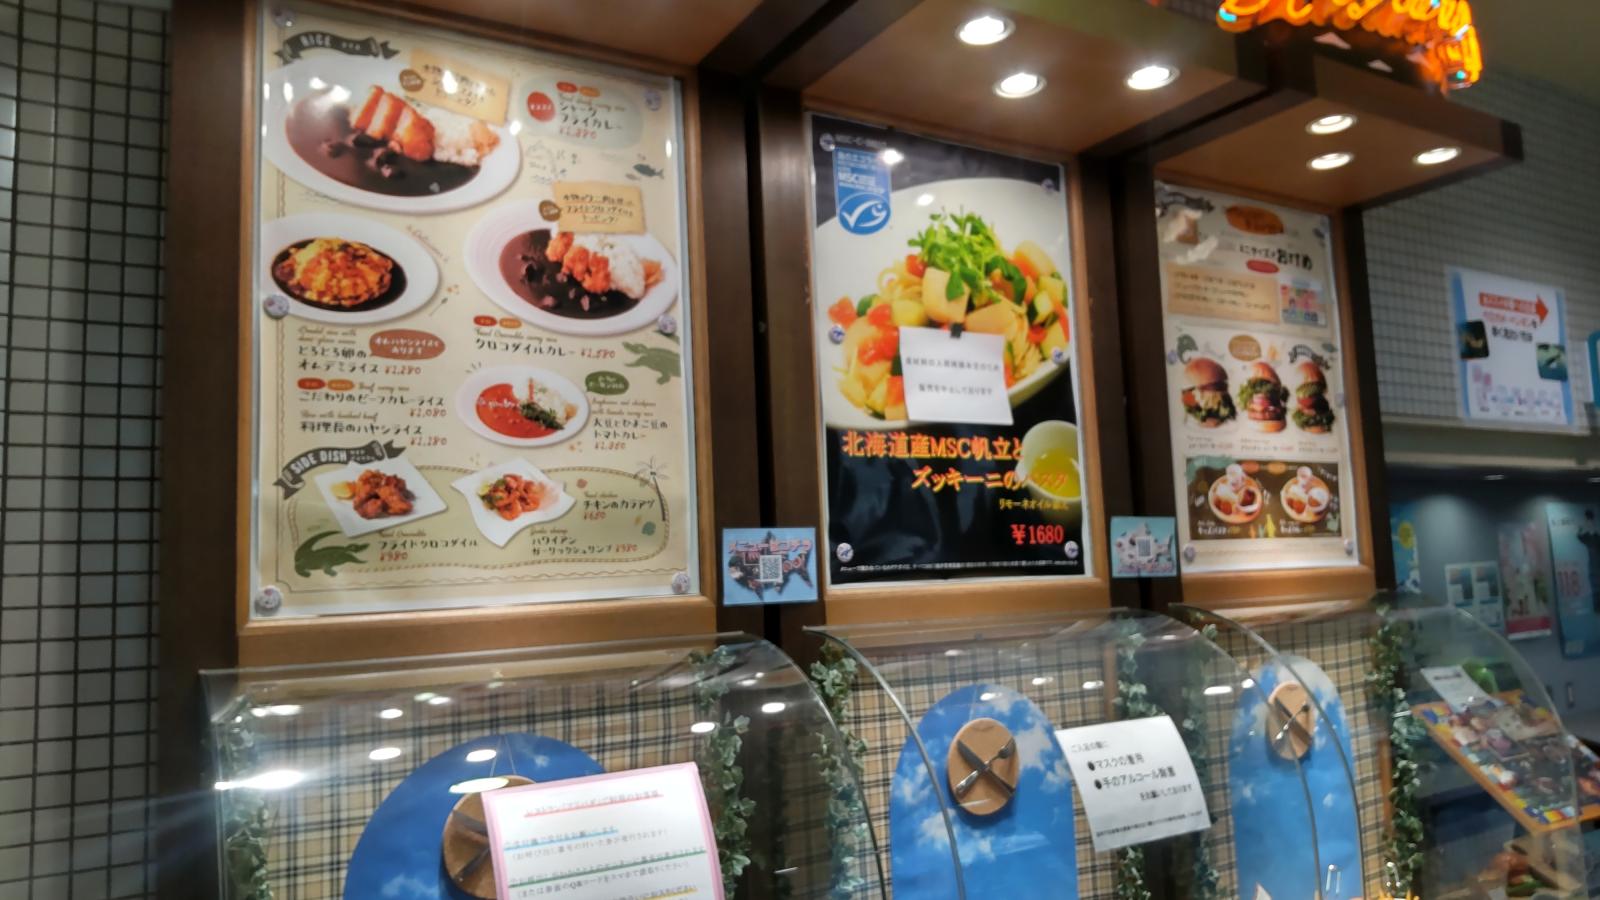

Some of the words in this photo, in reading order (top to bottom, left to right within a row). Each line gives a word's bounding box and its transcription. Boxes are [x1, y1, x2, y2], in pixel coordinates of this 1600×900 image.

[298, 344, 367, 359] とろとろ卵の
[475, 337, 576, 357] クロコダイルカレー
[298, 358, 378, 374] オムデミライス
[298, 392, 444, 406] こだわりのビーフカレーライス
[301, 421, 422, 435] 料理長のハヤシライス
[594, 429, 647, 440] トマトカレー
[841, 430, 1024, 461] 北海道産MSC帆立と
[290, 452, 318, 475] SIDE
[320, 449, 347, 462] DISH
[532, 535, 577, 546] ハワイアン
[1010, 524, 1064, 545] ¥1680
[379, 538, 478, 550] フライドクロコダイル
[532, 544, 612, 556] ガーリックシュリンプ
[1096, 753, 1145, 769] マスクの着用
